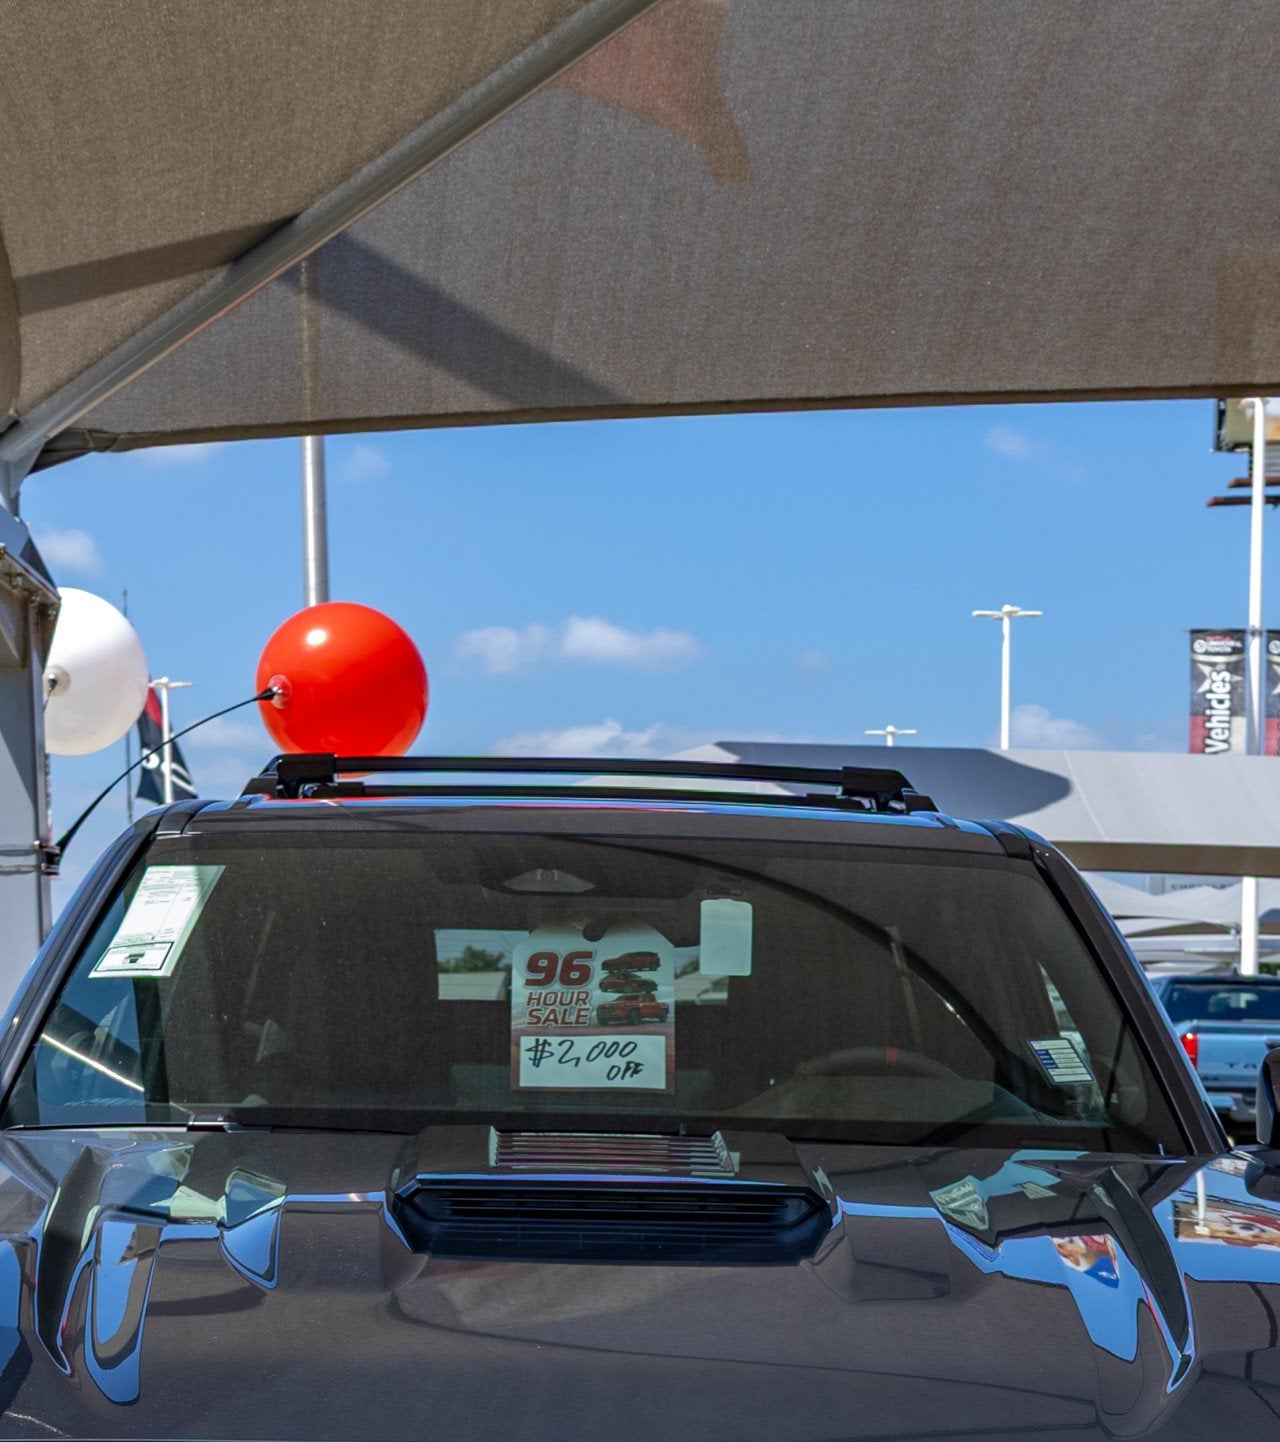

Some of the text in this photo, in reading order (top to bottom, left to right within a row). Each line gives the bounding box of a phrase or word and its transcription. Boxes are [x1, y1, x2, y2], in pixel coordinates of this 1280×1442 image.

[1205, 671, 1231, 754] Vehicles
[525, 952, 593, 986] 96
[527, 991, 589, 1006] HOUR
[527, 1008, 589, 1025] SALE
